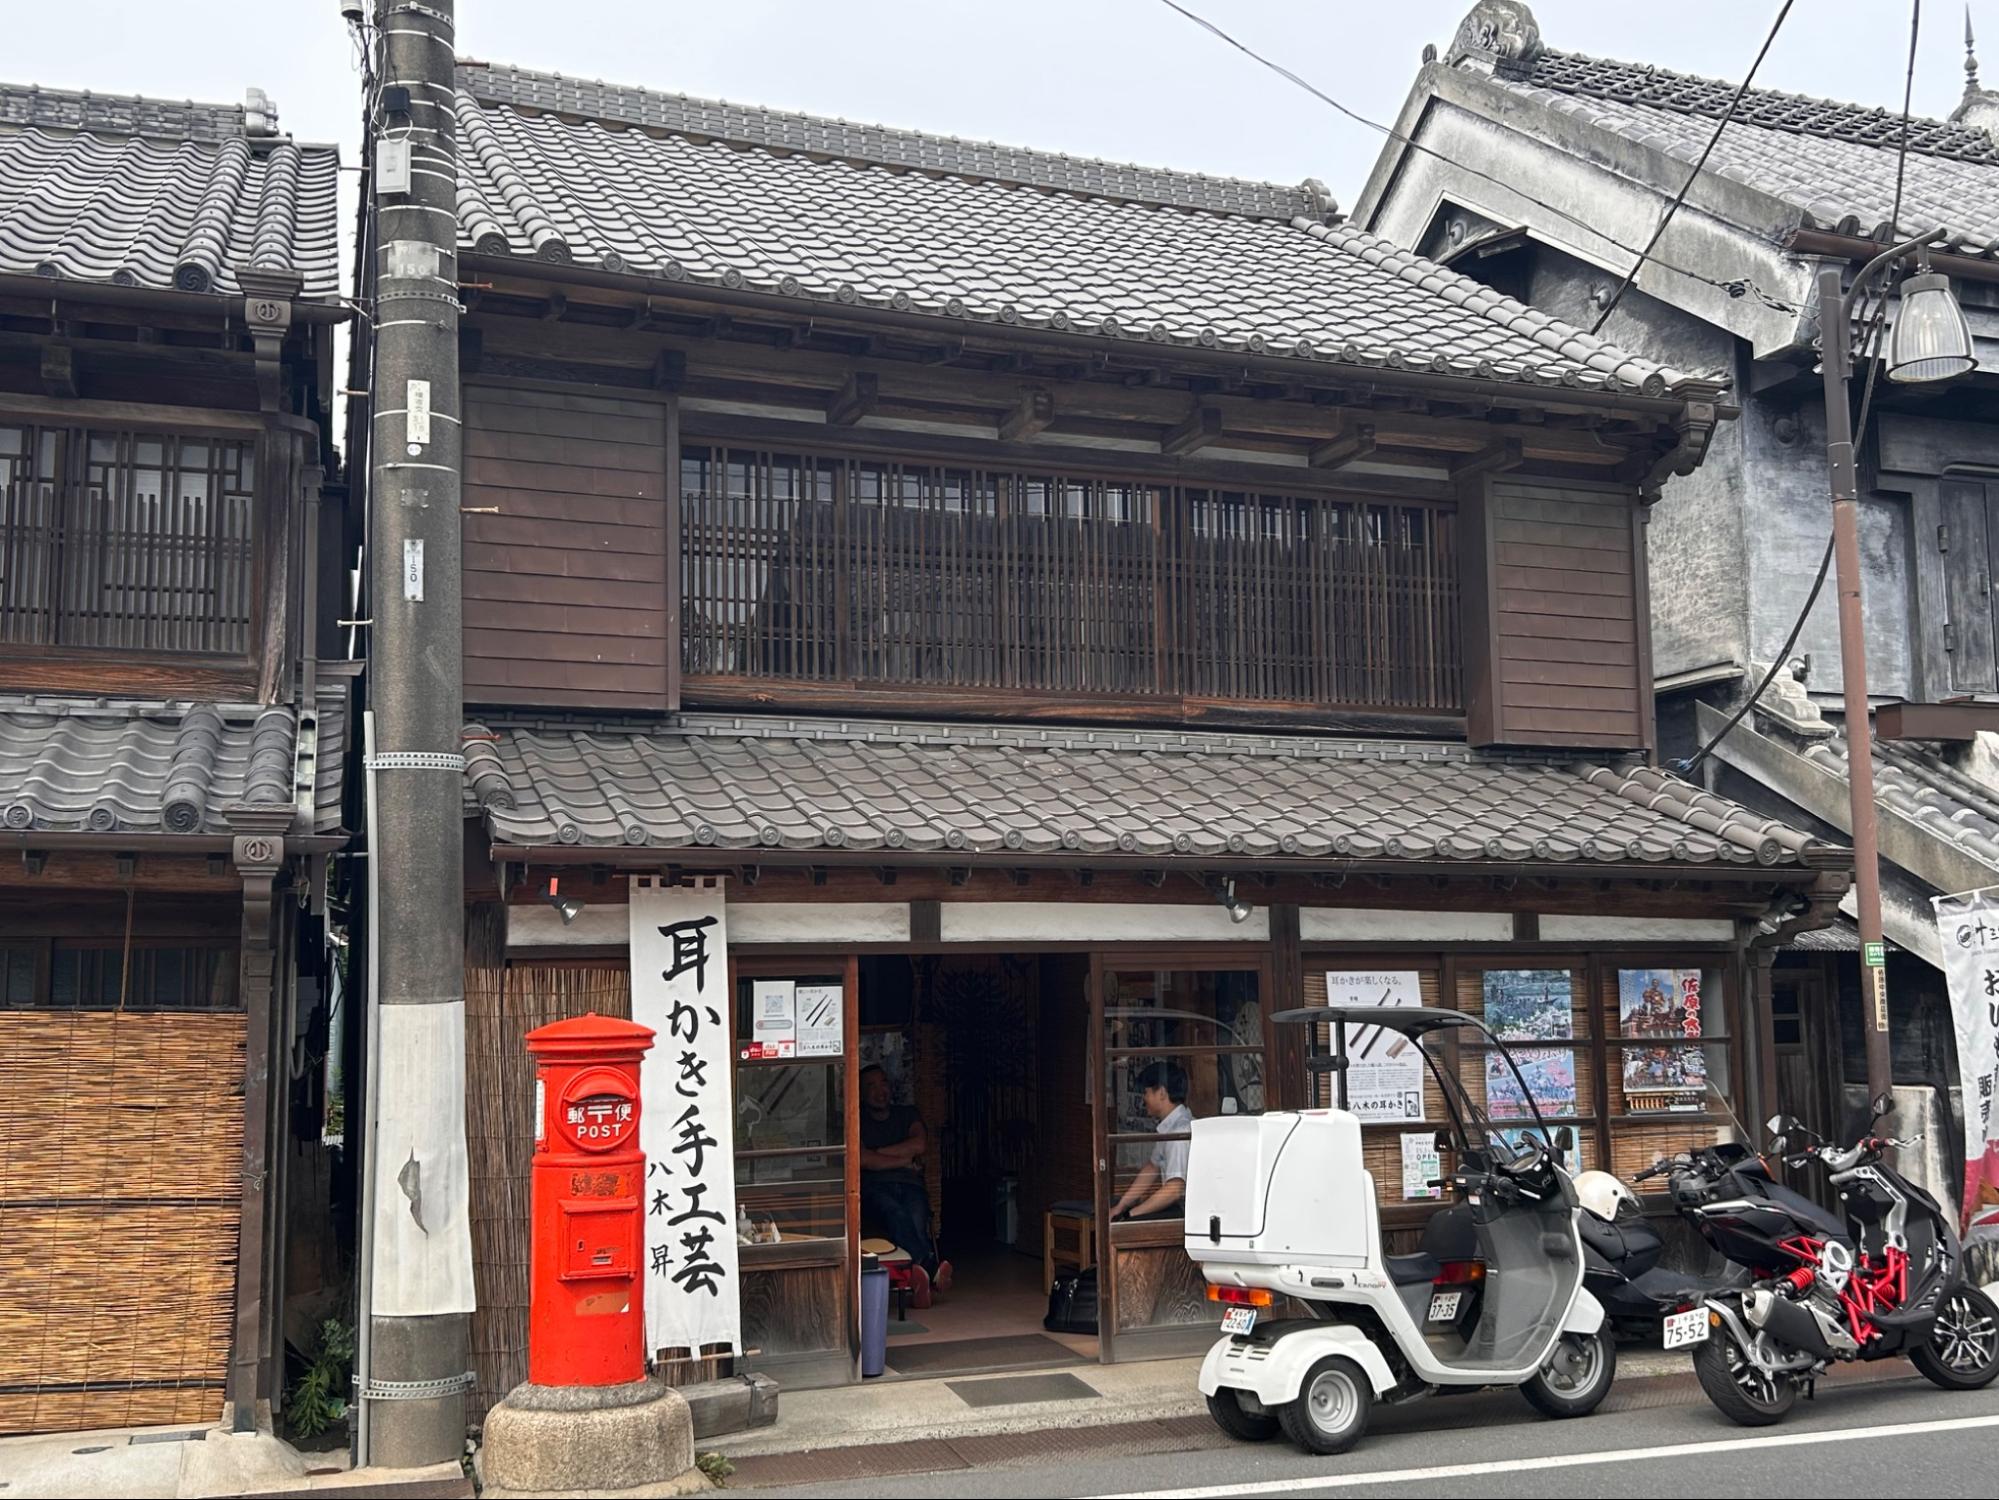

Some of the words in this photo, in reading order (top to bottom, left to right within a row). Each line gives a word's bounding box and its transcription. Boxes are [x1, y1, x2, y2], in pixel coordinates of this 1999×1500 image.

[658, 915, 726, 1297] 耳かき手工芸
[577, 1123, 622, 1139] POST
[1416, 1153, 1438, 1161] OPEN
